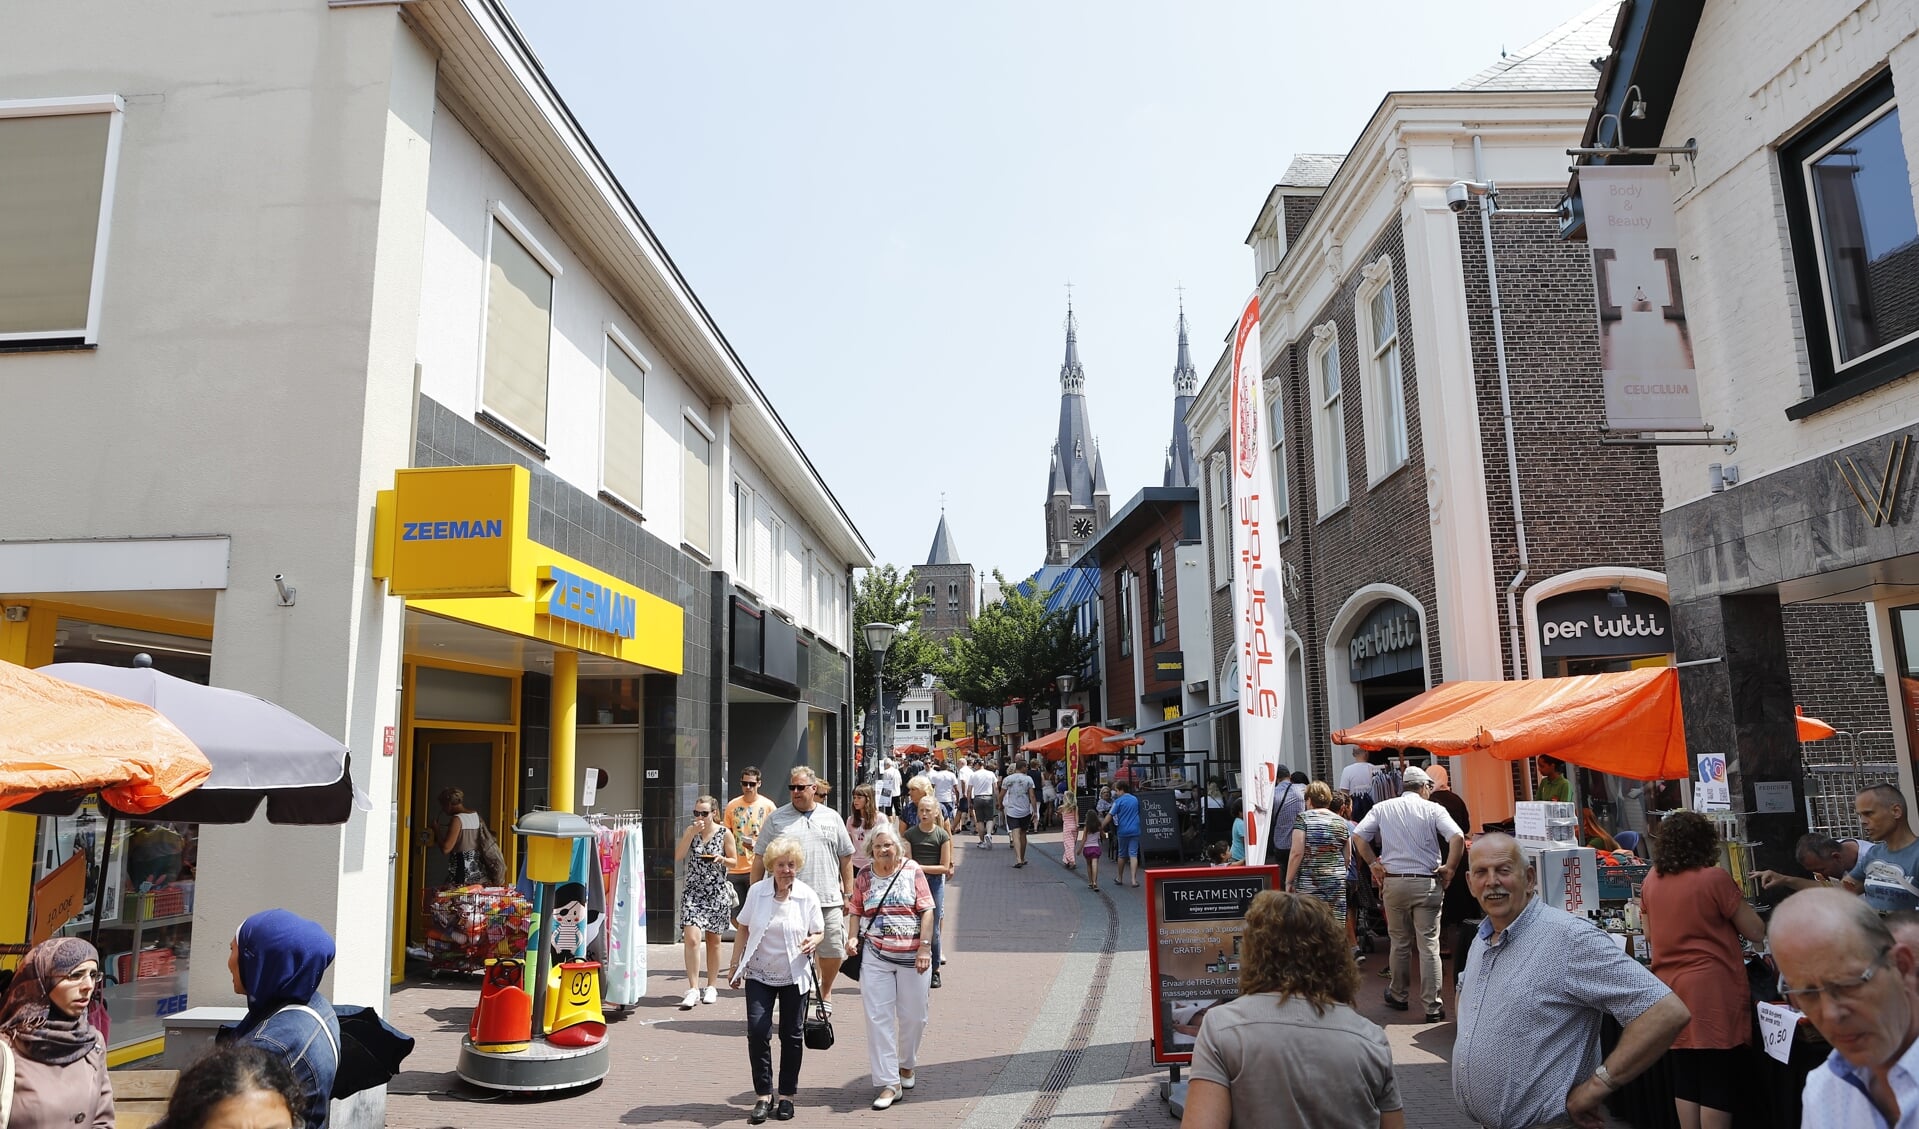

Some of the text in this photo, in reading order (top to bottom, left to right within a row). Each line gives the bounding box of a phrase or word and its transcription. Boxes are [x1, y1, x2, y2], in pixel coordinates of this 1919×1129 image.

[1609, 183, 1642, 199] Body
[1623, 199, 1633, 211] &
[1608, 215, 1653, 230] Beauty
[402, 519, 502, 541] ZEEMAN
[549, 564, 636, 640] ZEEMAN
[1350, 612, 1417, 664] per tutti
[1542, 614, 1665, 646] per tutti
[1160, 928, 1168, 936] Bij
[1170, 928, 1199, 936] aankoop
[1221, 925, 1243, 934] produ
[1208, 937, 1221, 945] dag
[1163, 990, 1198, 998] massages
[155, 994, 187, 1017] ZEE
